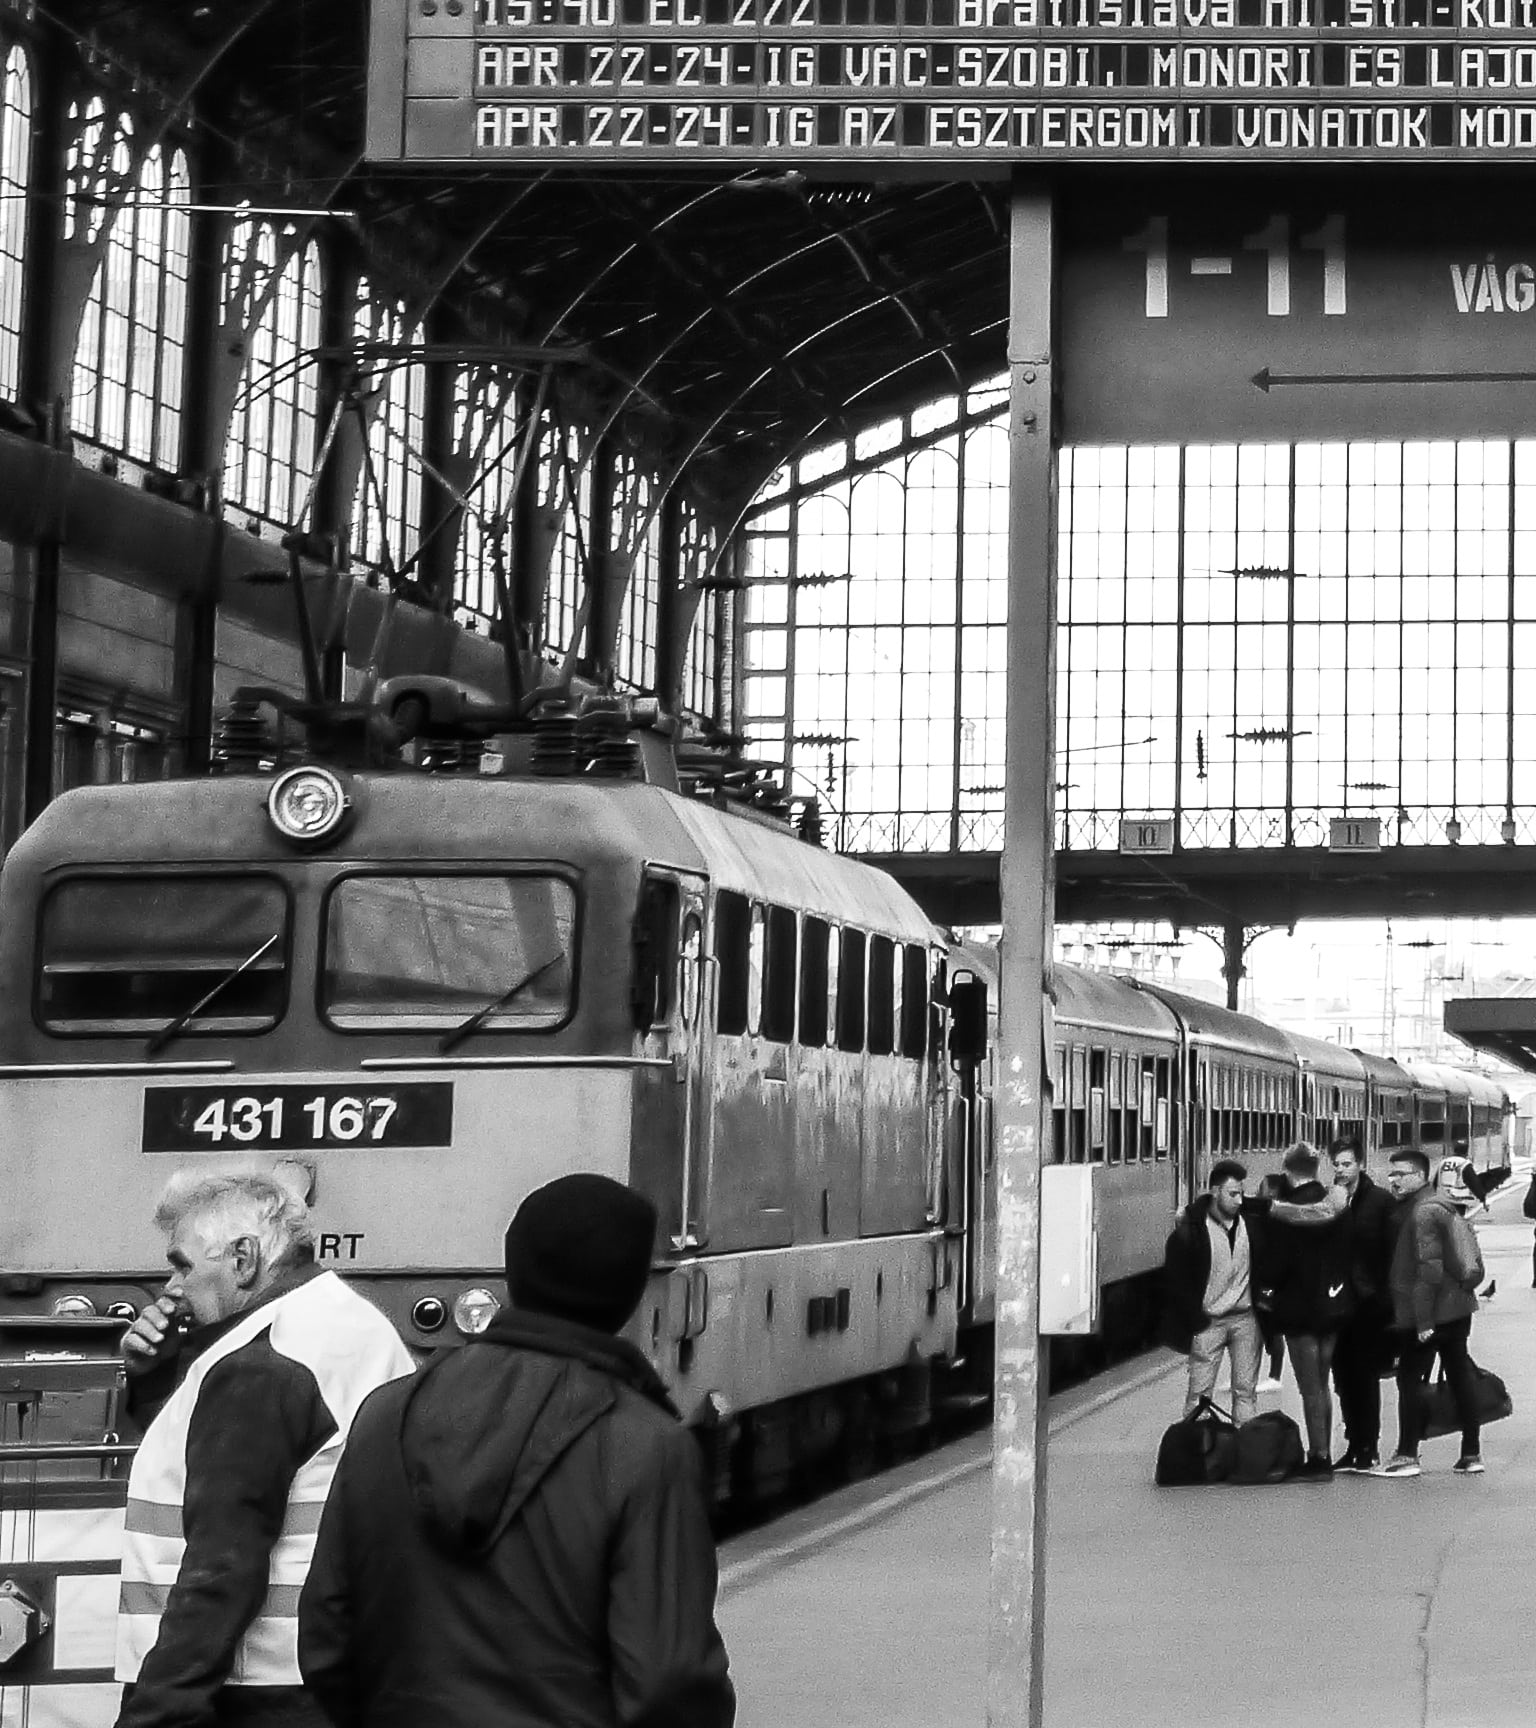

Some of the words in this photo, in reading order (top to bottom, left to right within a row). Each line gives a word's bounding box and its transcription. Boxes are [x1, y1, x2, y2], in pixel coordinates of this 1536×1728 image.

[1153, 46, 1312, 86] MONORI
[1348, 43, 1400, 86] ÉS
[844, 106, 897, 145] AZ
[928, 106, 1200, 145] ESZTERGOMI
[1236, 106, 1428, 146] VONATOK
[1121, 214, 1349, 319] 1-11
[193, 1098, 283, 1141] 431
[304, 1096, 398, 1139] 167
